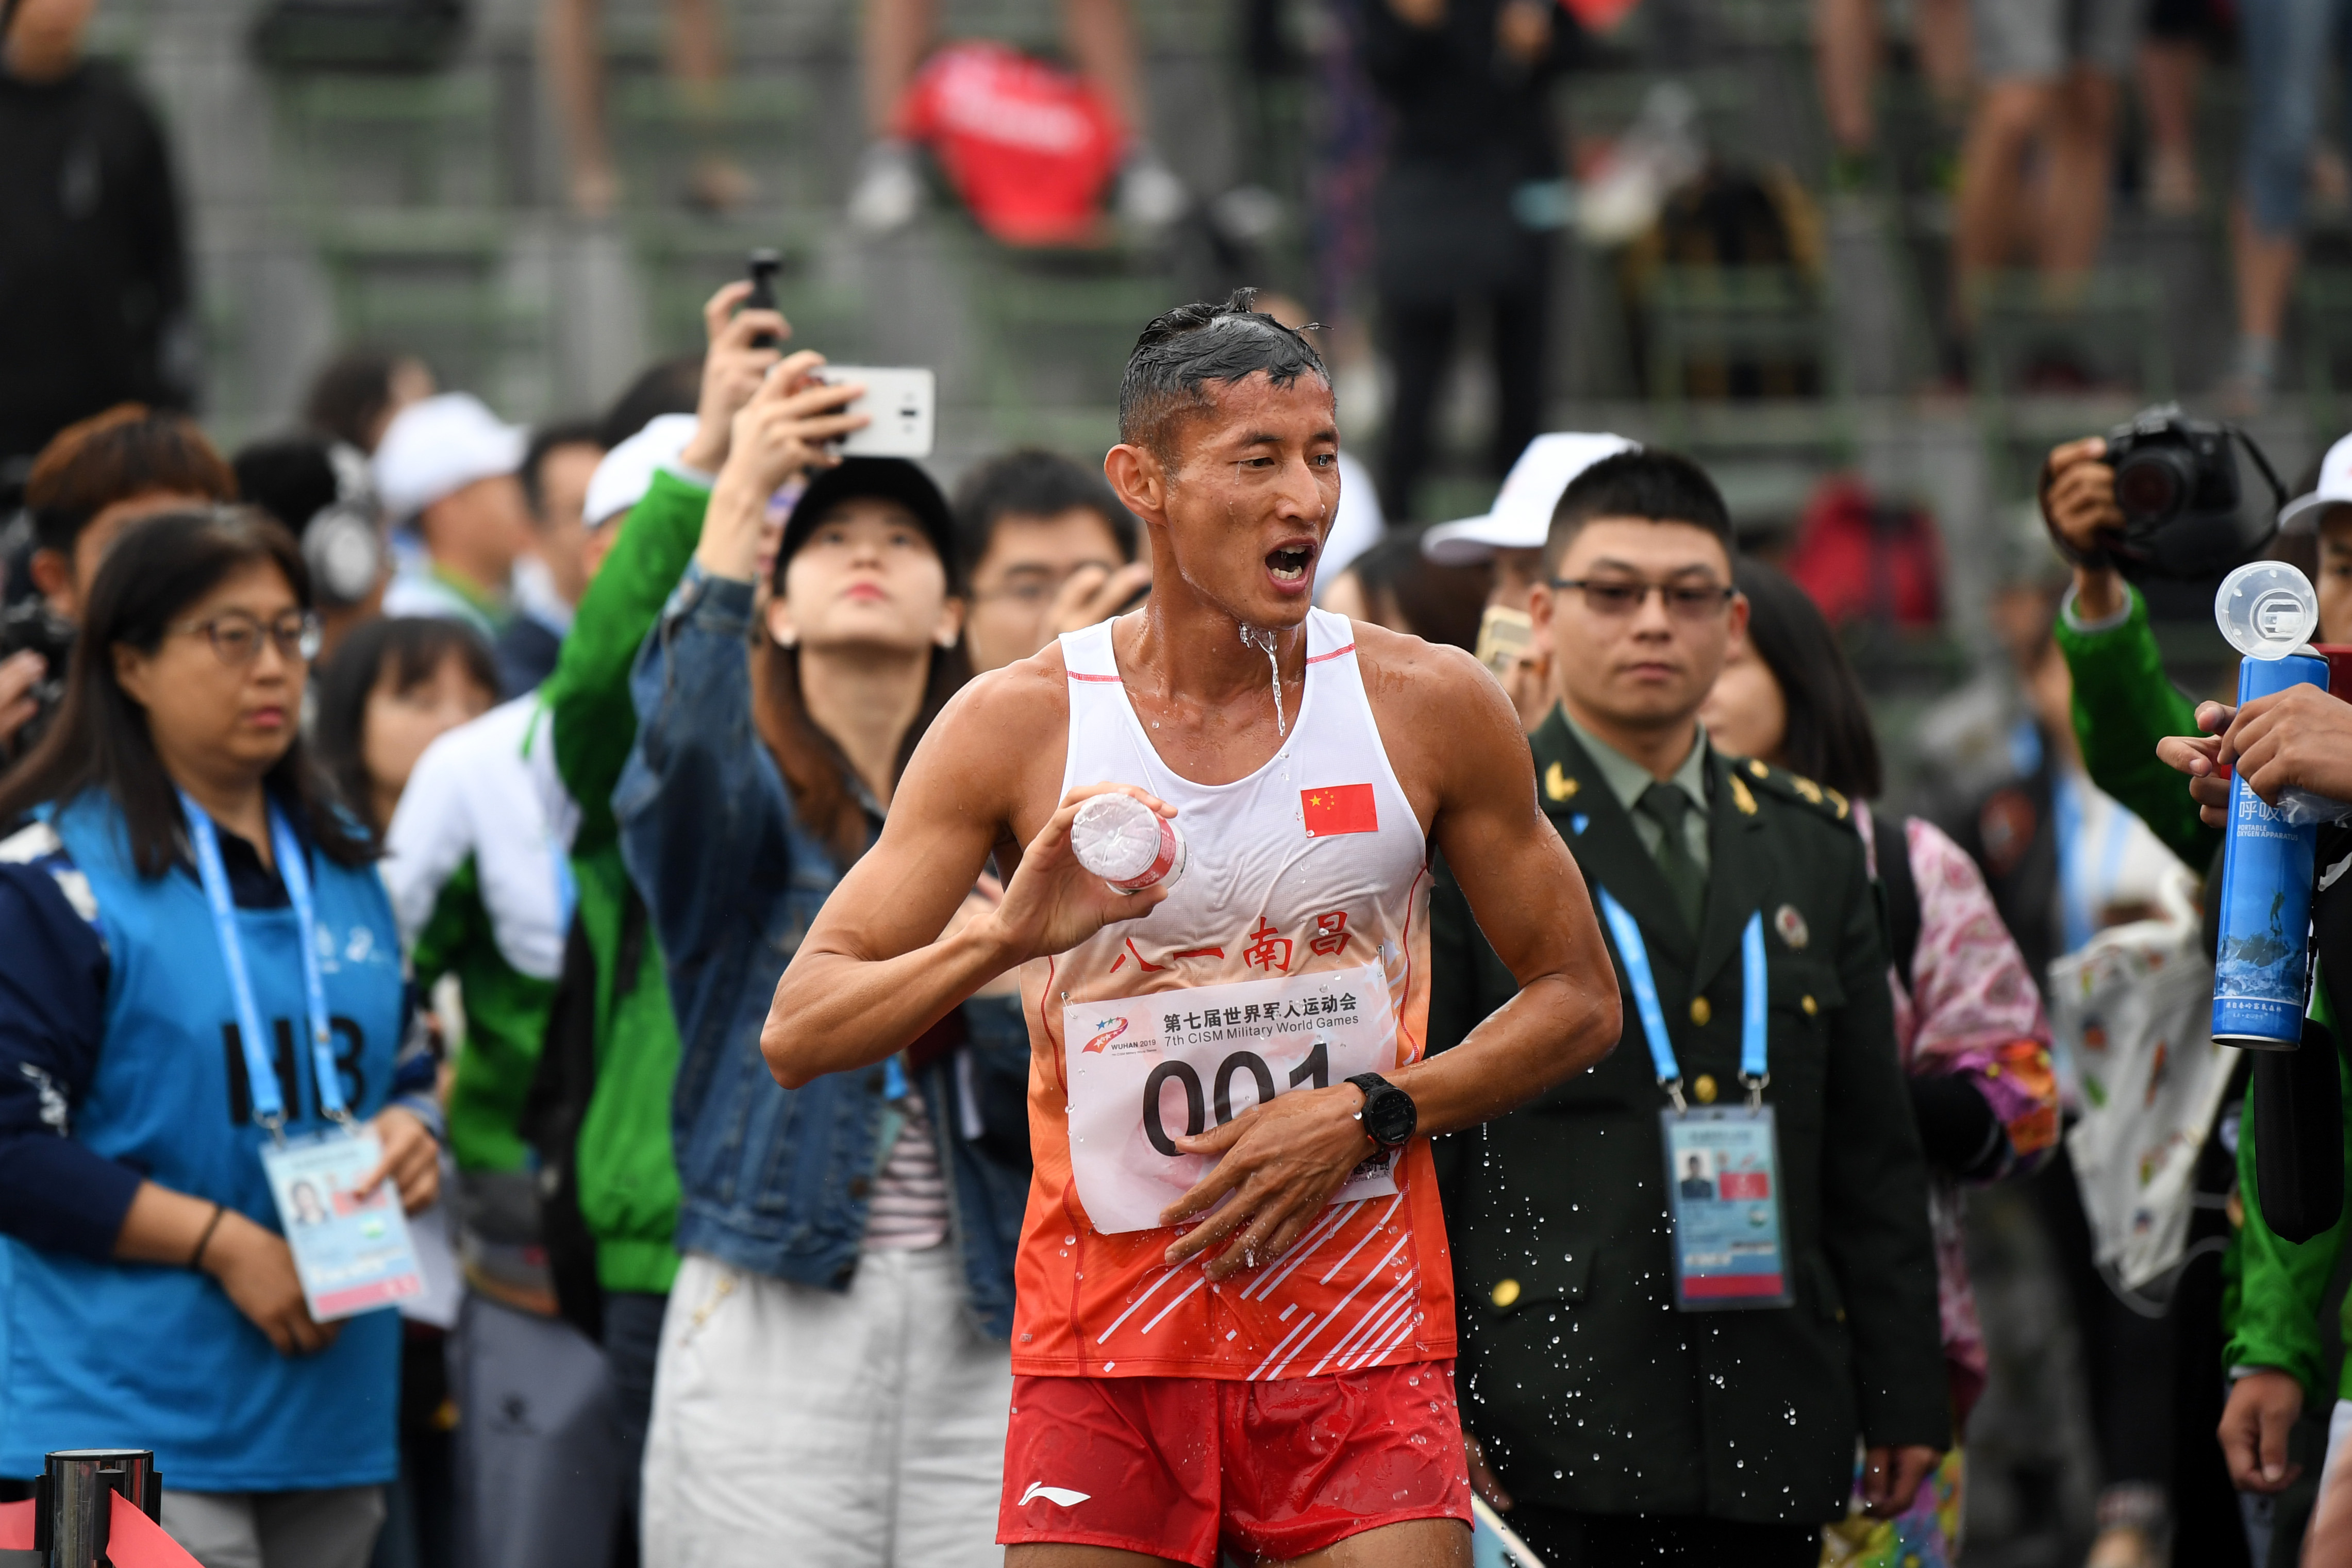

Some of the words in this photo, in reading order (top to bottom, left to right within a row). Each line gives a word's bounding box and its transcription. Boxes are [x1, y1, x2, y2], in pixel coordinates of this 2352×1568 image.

[2260, 831, 2299, 841] APPARATUS
[1109, 911, 1352, 973] 八一南昌
[1163, 992, 1357, 1033] 第七届世界军人运动会
[1111, 1041, 1138, 1050] WUHAN
[1140, 1039, 1156, 1047] 2019
[1164, 1035, 1184, 1047] 7th
[1188, 1029, 1223, 1044] CISM
[1227, 1026, 1273, 1039] Military
[1276, 1019, 1313, 1033] World
[1316, 1015, 1359, 1028] Games
